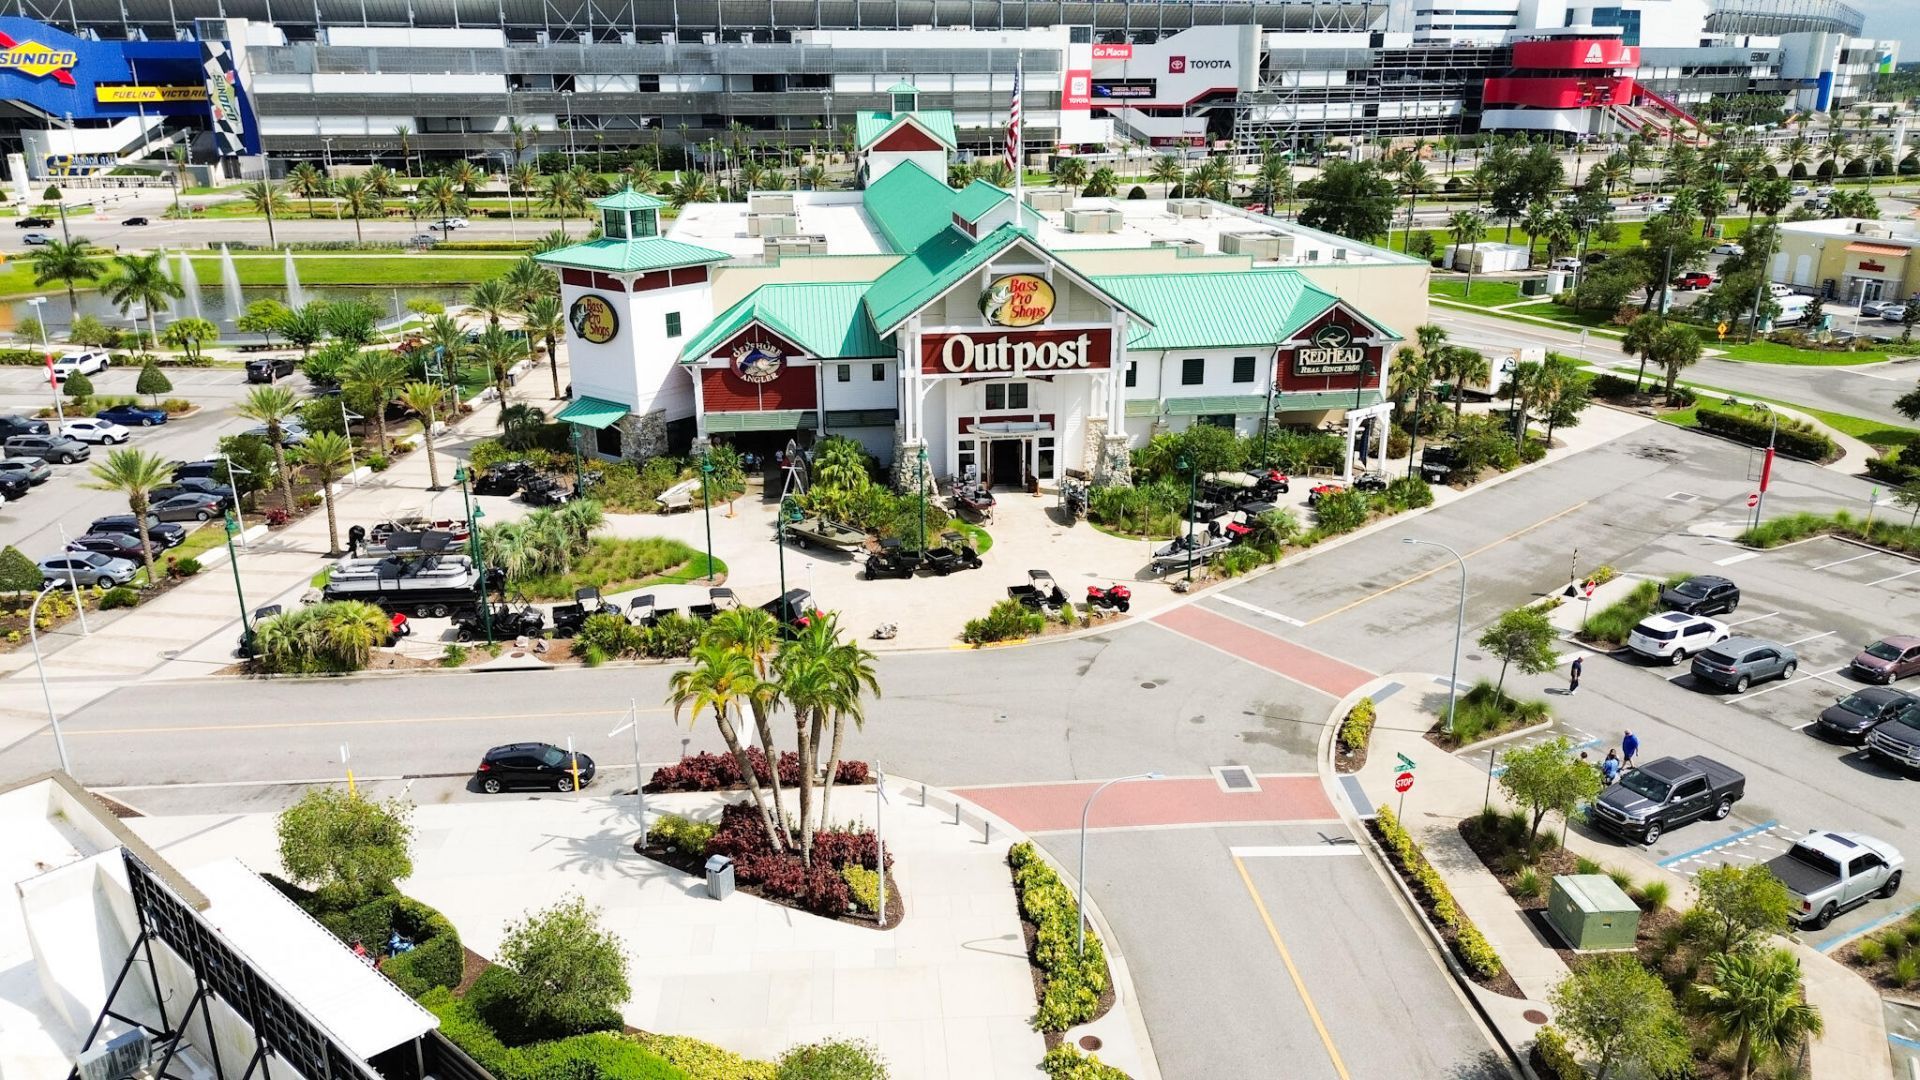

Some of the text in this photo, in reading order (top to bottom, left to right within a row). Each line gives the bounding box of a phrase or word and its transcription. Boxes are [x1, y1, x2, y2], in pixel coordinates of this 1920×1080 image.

[0, 52, 73, 65] SUNOCO
[1093, 47, 1129, 57] Go Places
[1189, 60, 1232, 69] TOYOTA
[112, 91, 157, 99] FUELING
[212, 74, 239, 122] SUNOCO
[1010, 278, 1039, 293] Bass
[586, 298, 604, 314] Bass
[1010, 292, 1032, 306] Pro
[588, 311, 601, 325] Pro
[1011, 305, 1046, 321] Shops
[589, 323, 610, 339] Shops
[732, 341, 783, 358] OFFSHORE
[942, 333, 1092, 379] Outpost
[740, 372, 779, 383] ANGLER
[1395, 777, 1414, 788] STOP
